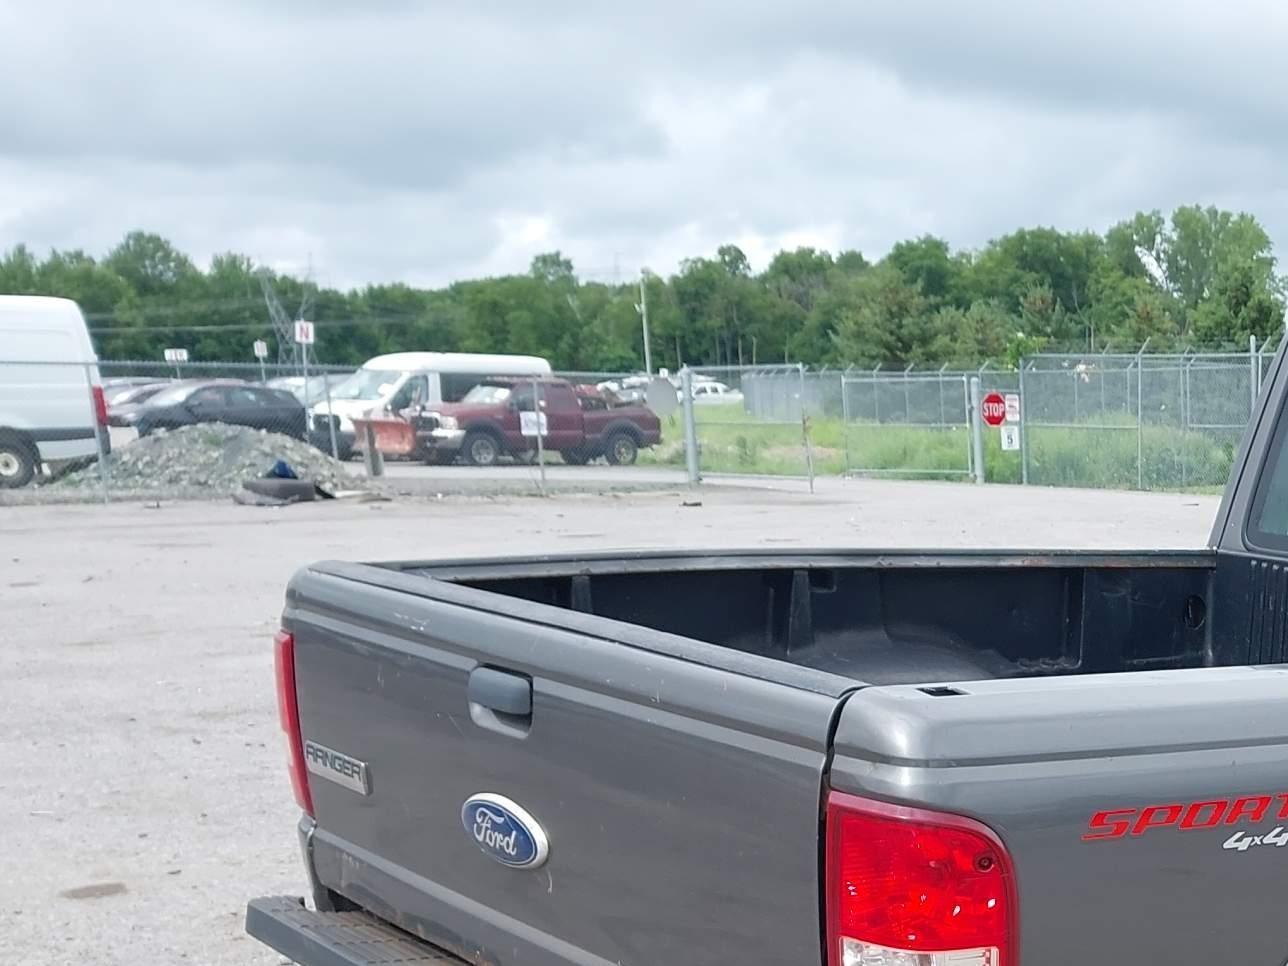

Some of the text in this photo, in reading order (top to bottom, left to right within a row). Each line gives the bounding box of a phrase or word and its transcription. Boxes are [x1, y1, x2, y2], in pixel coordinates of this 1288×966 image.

[983, 402, 1005, 417] STOP
[305, 743, 361, 782] RANGER
[474, 807, 517, 855] Ford
